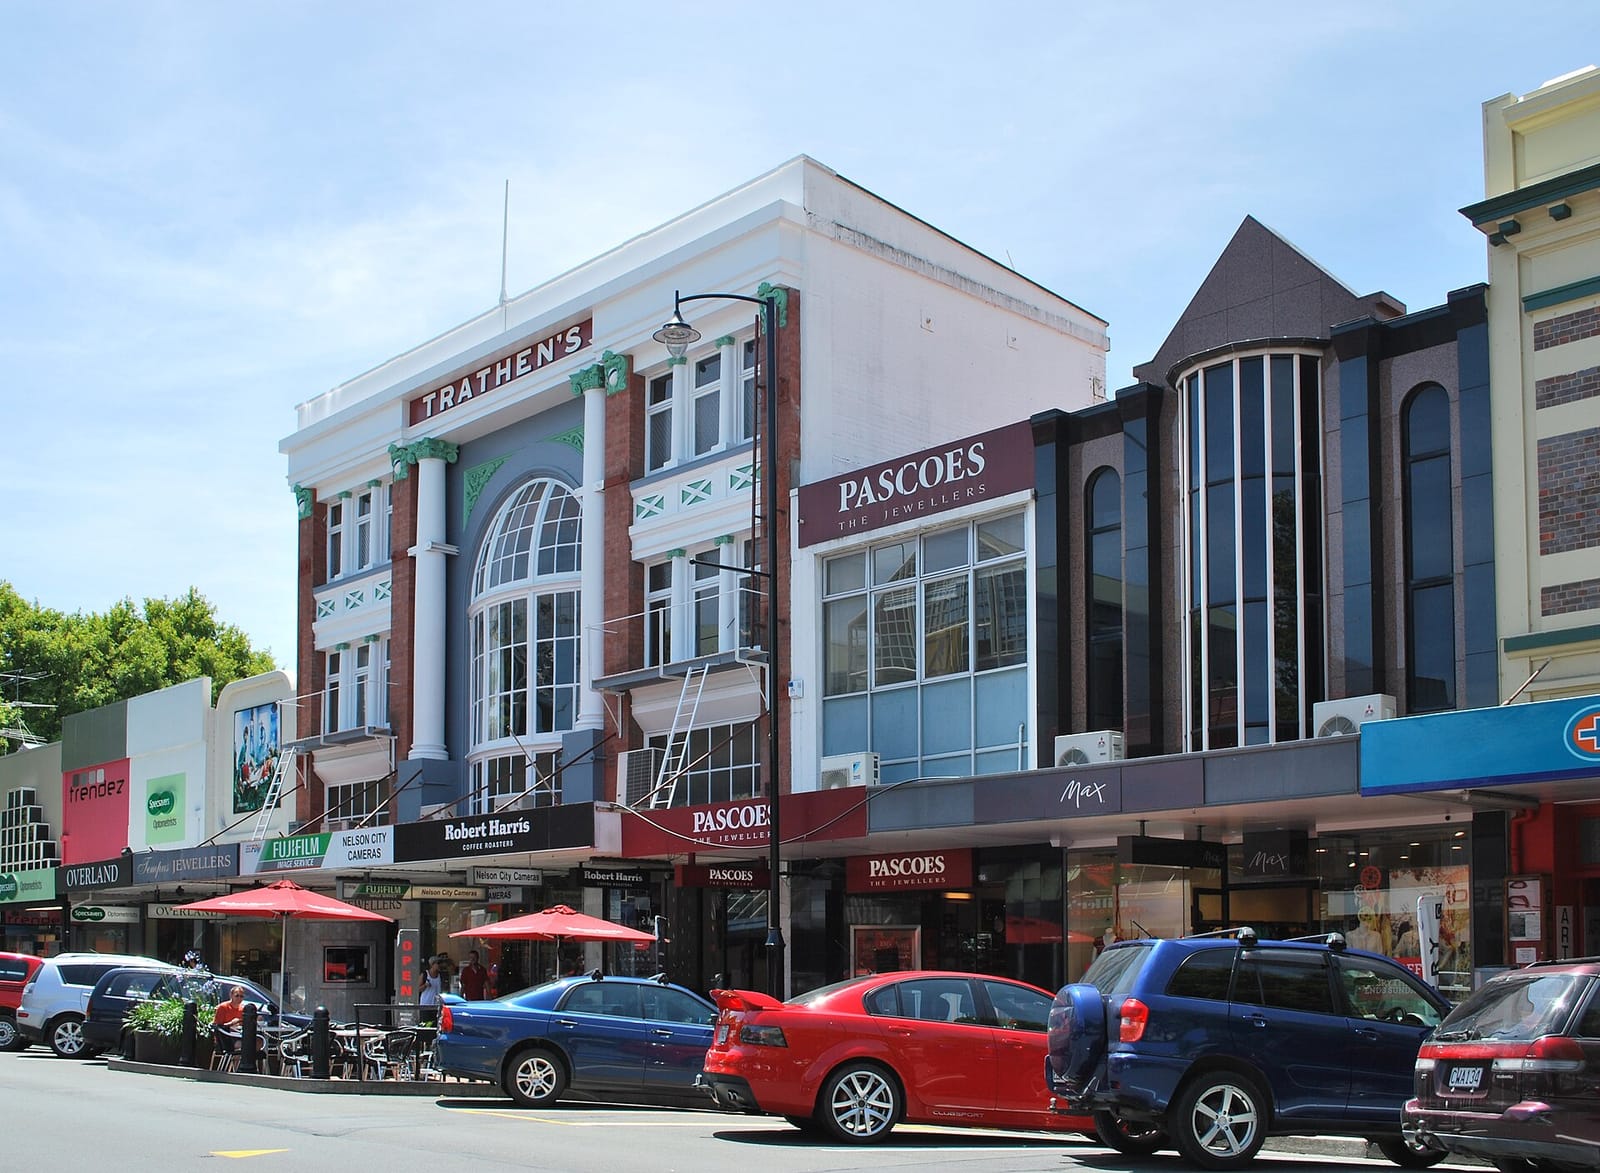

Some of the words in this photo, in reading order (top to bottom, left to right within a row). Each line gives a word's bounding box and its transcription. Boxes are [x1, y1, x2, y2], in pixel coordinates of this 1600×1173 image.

[422, 326, 582, 418] TRATHEN'S
[838, 442, 986, 513] PASCOES
[838, 515, 869, 531] THE
[882, 484, 987, 521] JEWELLERS
[69, 779, 125, 803] trendez
[1060, 780, 1107, 809] Max
[342, 836, 370, 847] NELSON
[370, 832, 388, 844] CITY
[444, 822, 487, 841] Robert
[272, 837, 320, 859] FUJIFILM
[347, 847, 382, 861] CAMERAS
[462, 842, 483, 852] COFFEE
[484, 839, 514, 850] ROASTERS
[172, 854, 232, 873] JEWELLERS
[293, 858, 314, 867] SERVICE
[868, 855, 946, 878] PASCOES
[1248, 851, 1287, 873] Max
[66, 863, 119, 887] OVERLAND
[475, 870, 498, 880] Nelson
[499, 871, 512, 882] City
[513, 872, 540, 881] Cameras
[584, 870, 615, 881] Robert
[615, 872, 643, 882] Harris
[709, 869, 753, 881] PASCOES
[893, 877, 946, 887] JEWELLERS
[365, 885, 402, 895] FUJIFILM
[421, 888, 441, 896] Nelson
[441, 889, 453, 898] City
[73, 909, 104, 918] Specsavers
[400, 940, 413, 997] OPEN
